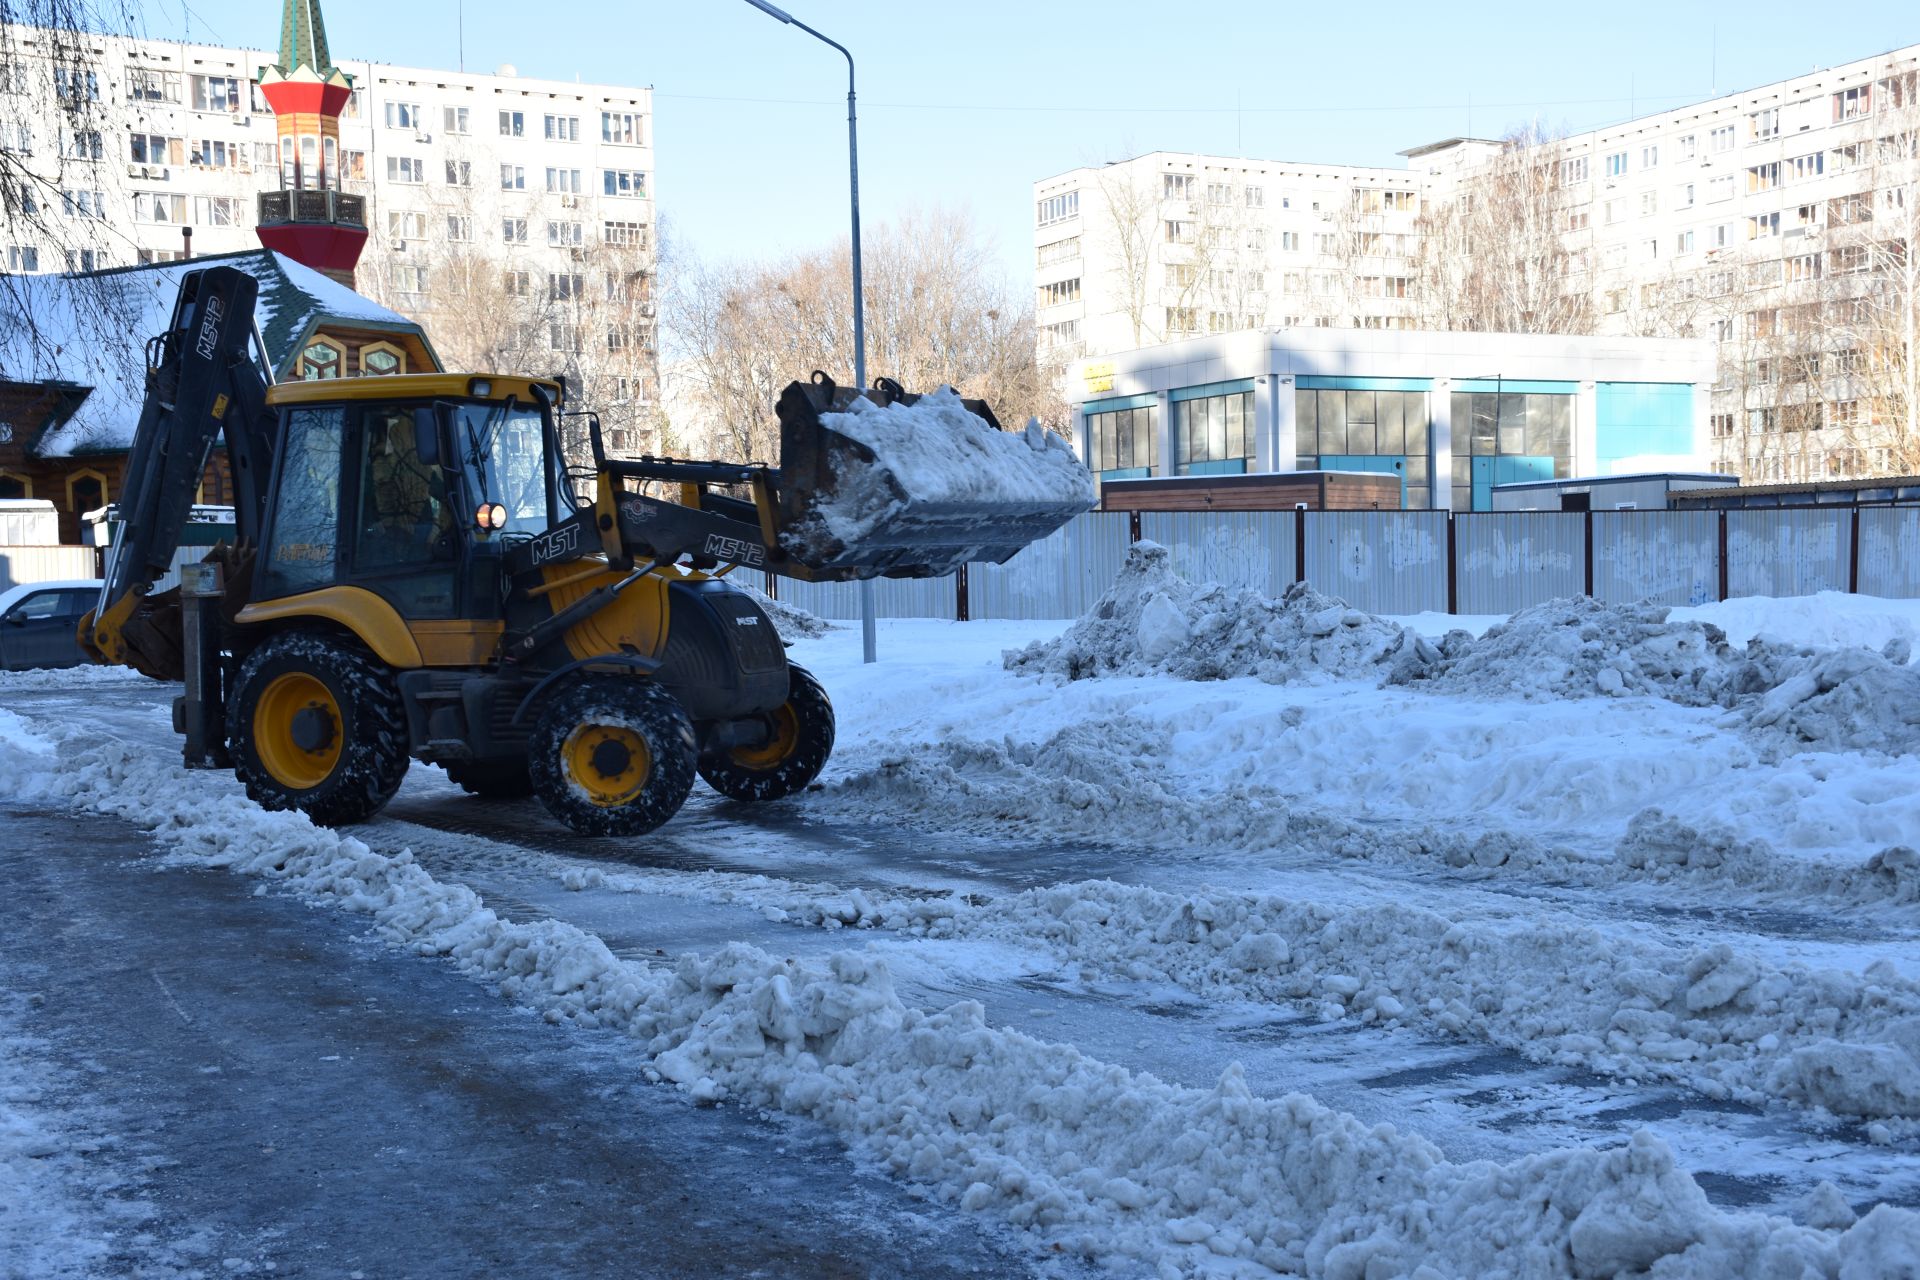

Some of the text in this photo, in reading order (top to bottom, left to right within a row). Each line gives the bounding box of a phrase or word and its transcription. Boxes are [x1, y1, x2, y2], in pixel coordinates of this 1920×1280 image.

[532, 522, 580, 565] MST
[704, 533, 766, 566] M542
[736, 616, 758, 626] MST
